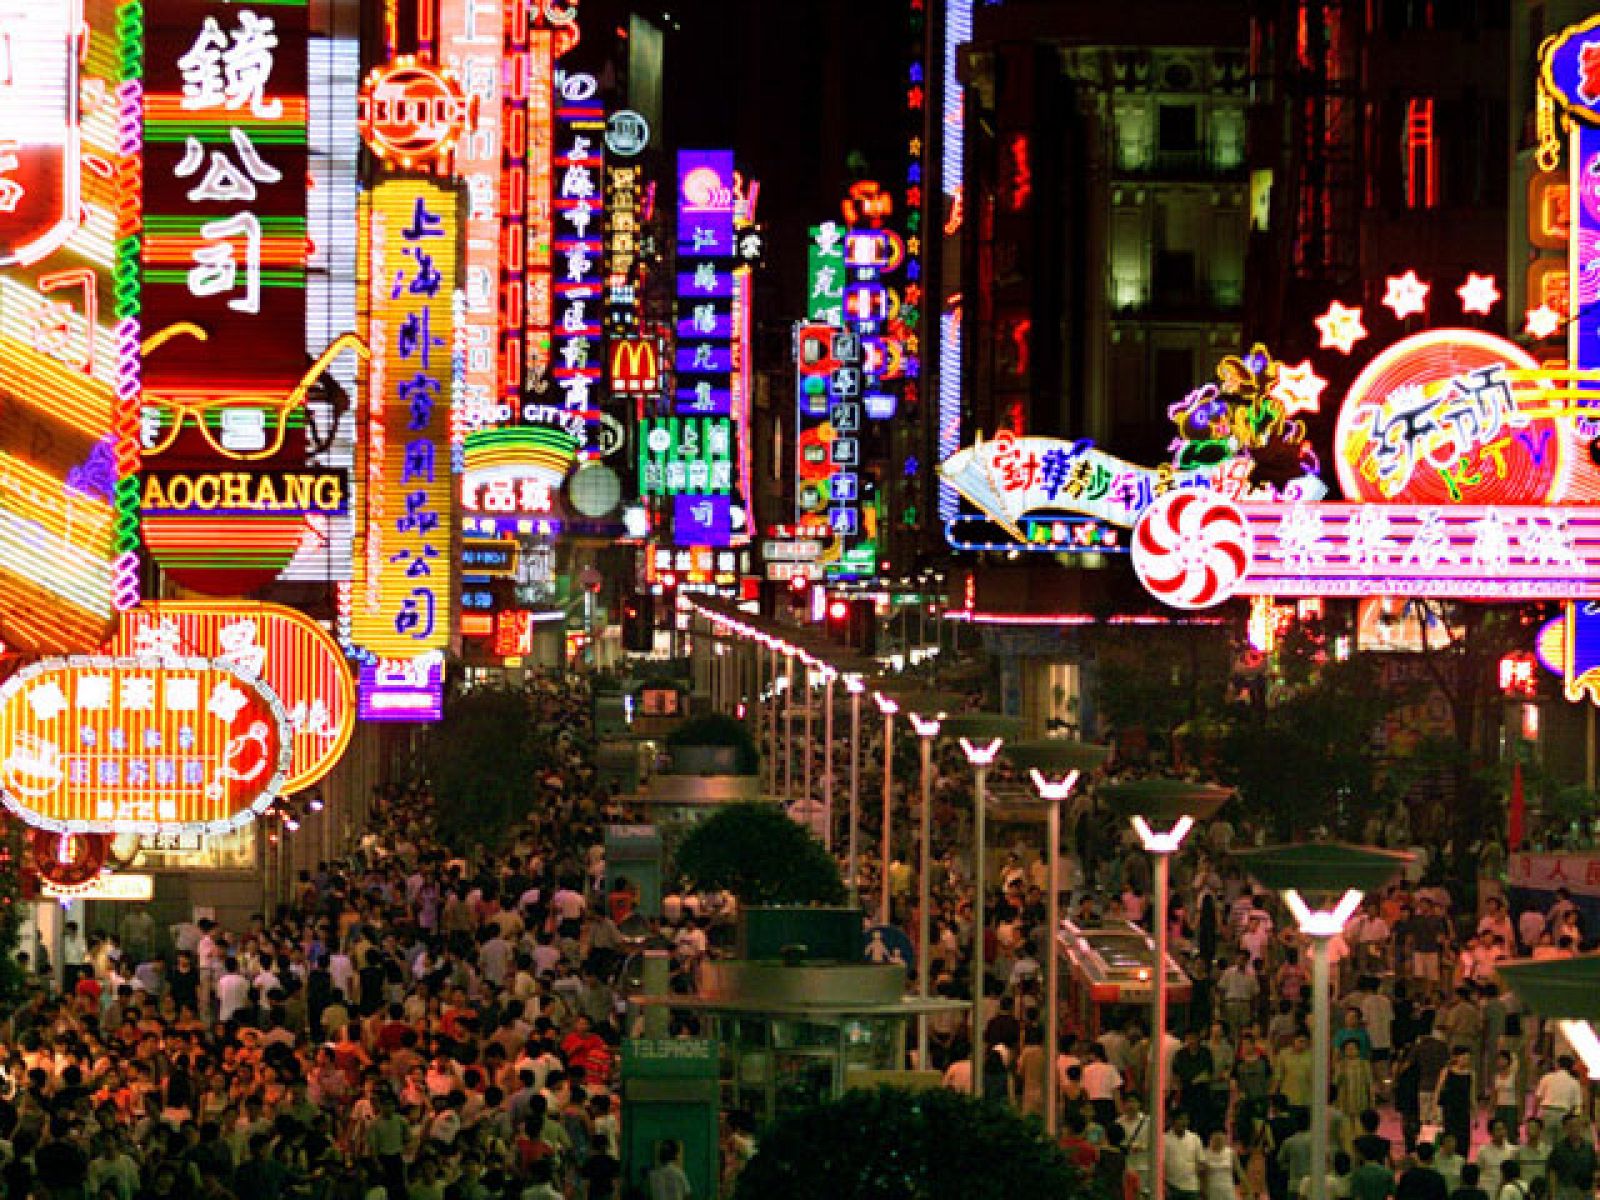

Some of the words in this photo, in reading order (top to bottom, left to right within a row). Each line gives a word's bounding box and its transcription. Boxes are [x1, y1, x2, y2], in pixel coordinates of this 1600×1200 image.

[174, 10, 284, 314] 鏡公司
[143, 473, 342, 510] AOCHANG
[1439, 428, 1554, 502] KTV
